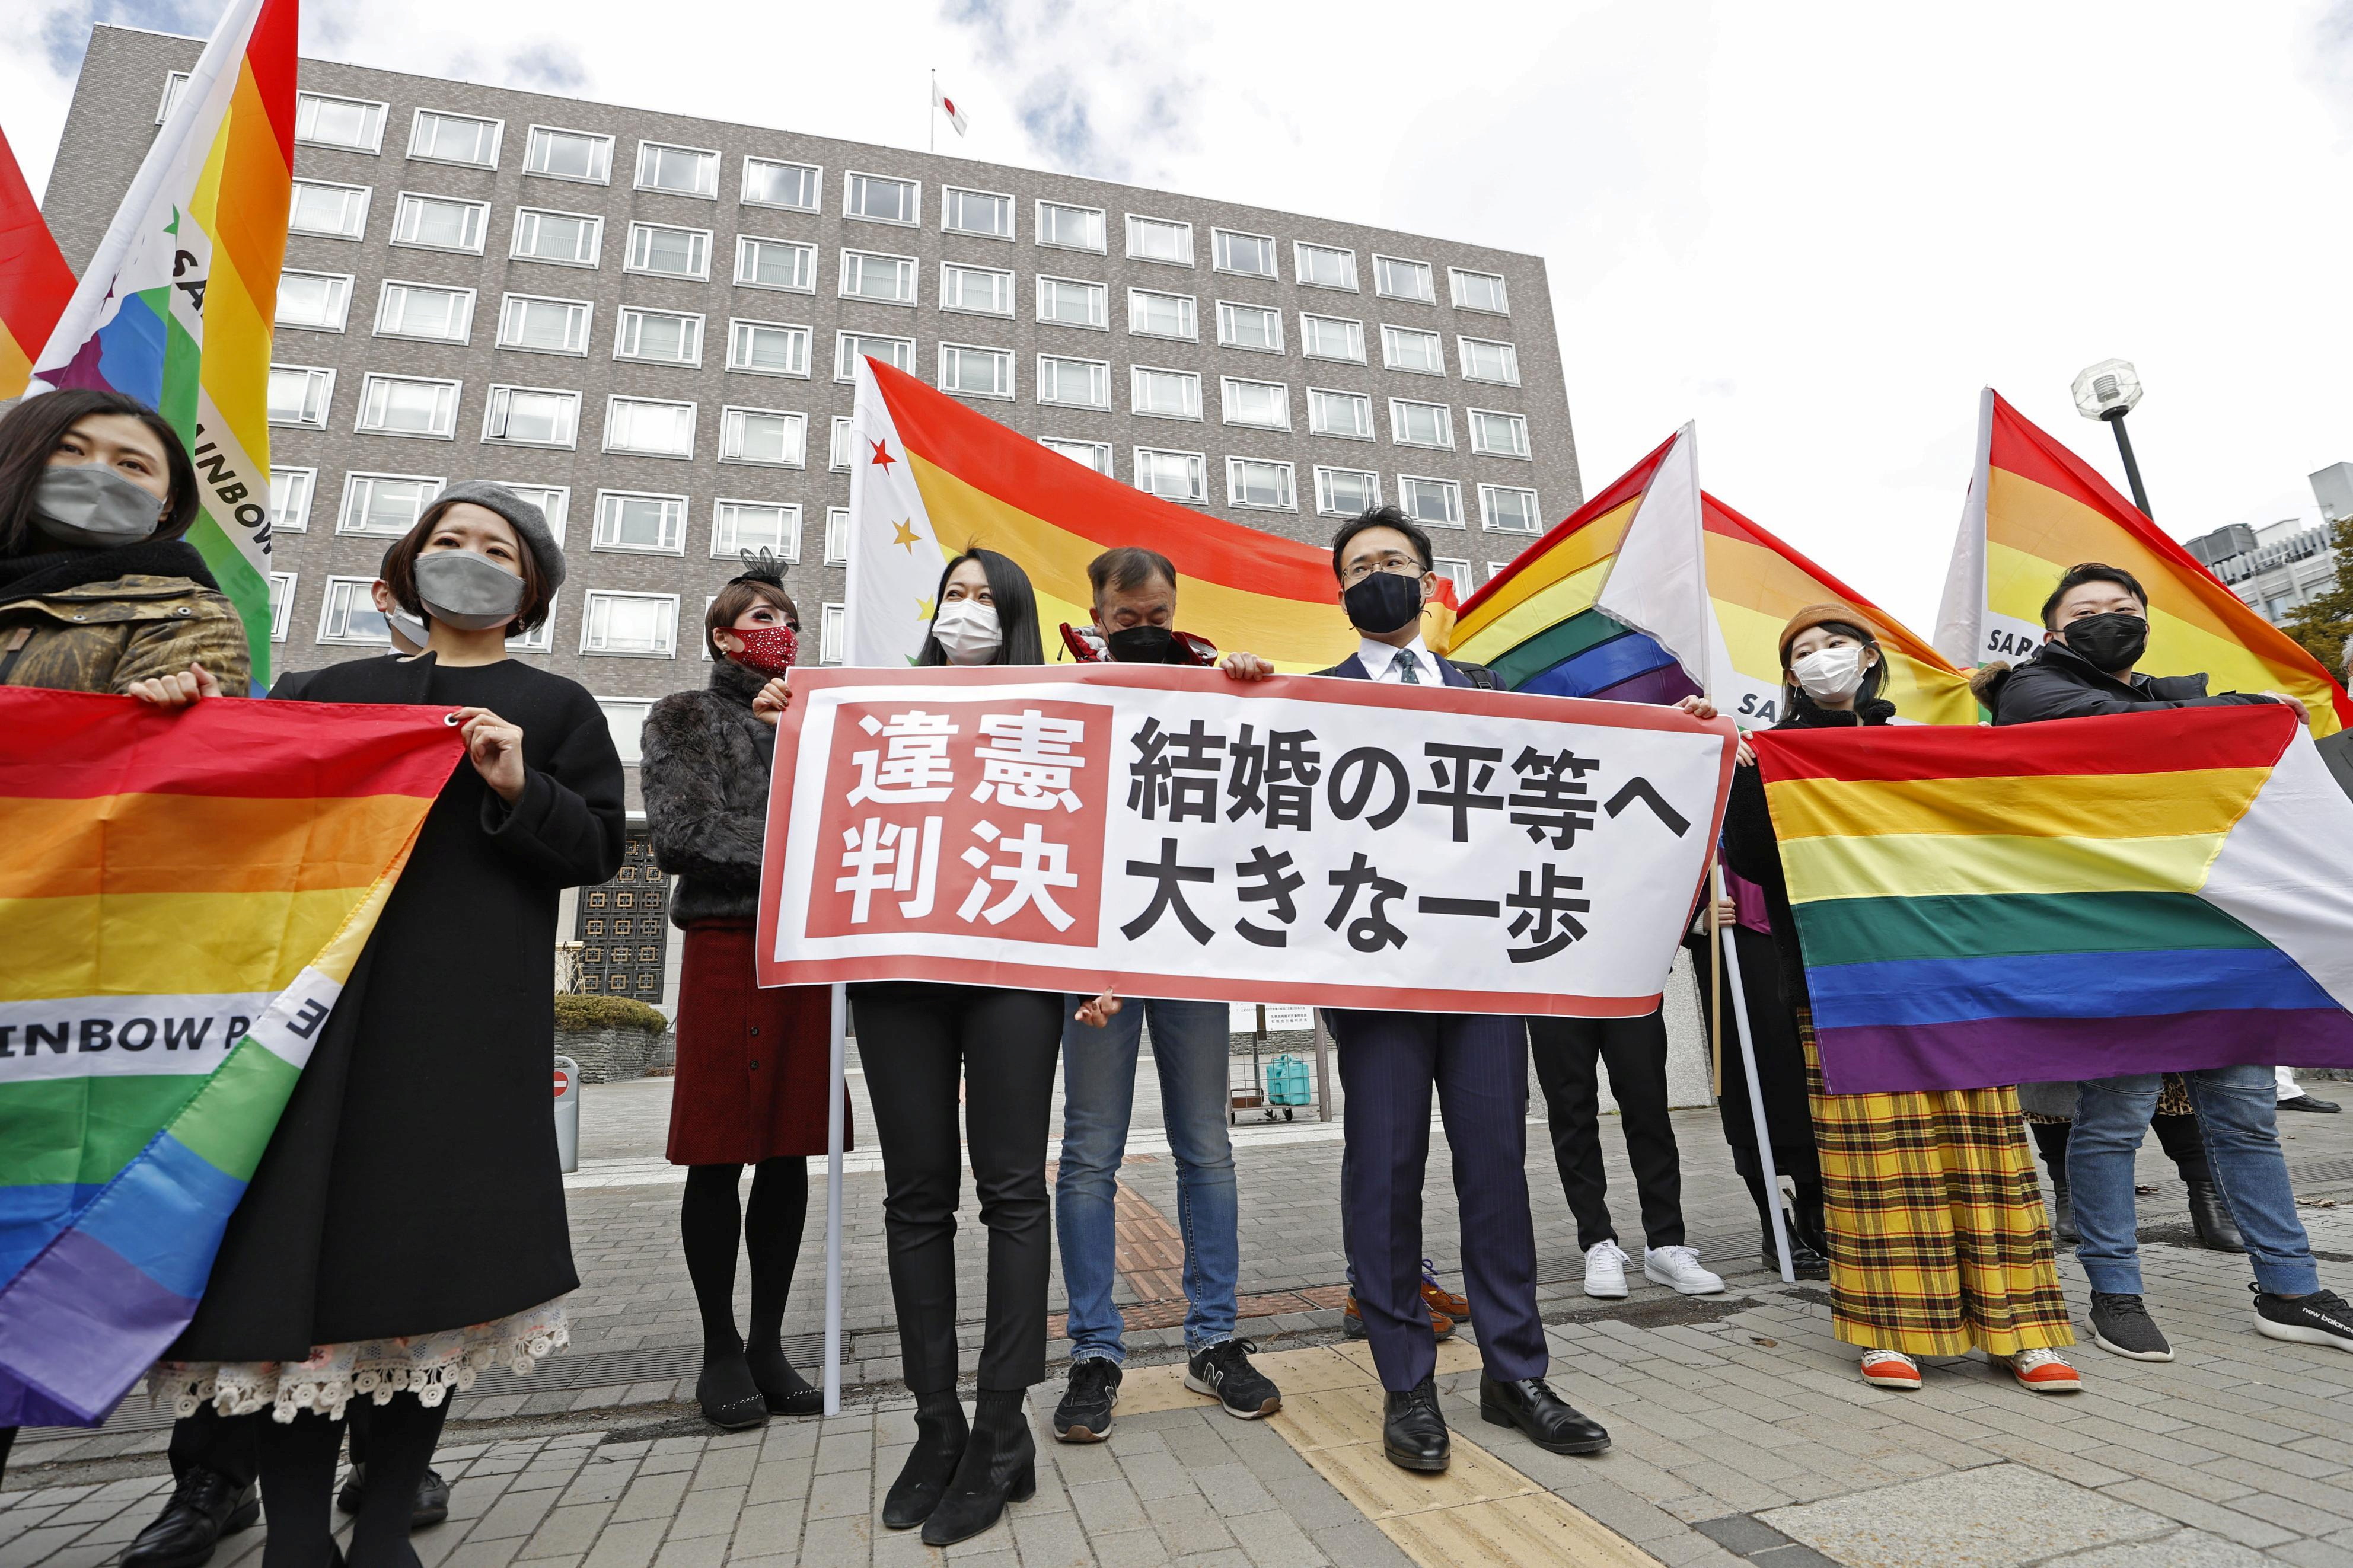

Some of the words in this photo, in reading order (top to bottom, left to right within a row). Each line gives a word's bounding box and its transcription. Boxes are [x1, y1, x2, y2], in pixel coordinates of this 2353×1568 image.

[173, 250, 207, 319] SA
[846, 708, 1085, 812] 違憲
[1127, 716, 1691, 851] 結婚の平等へ
[834, 815, 1078, 933] 判決
[1120, 837, 1590, 963] 大きな一歩
[224, 1015, 262, 1049] P
[2302, 1307, 2321, 1318] new
